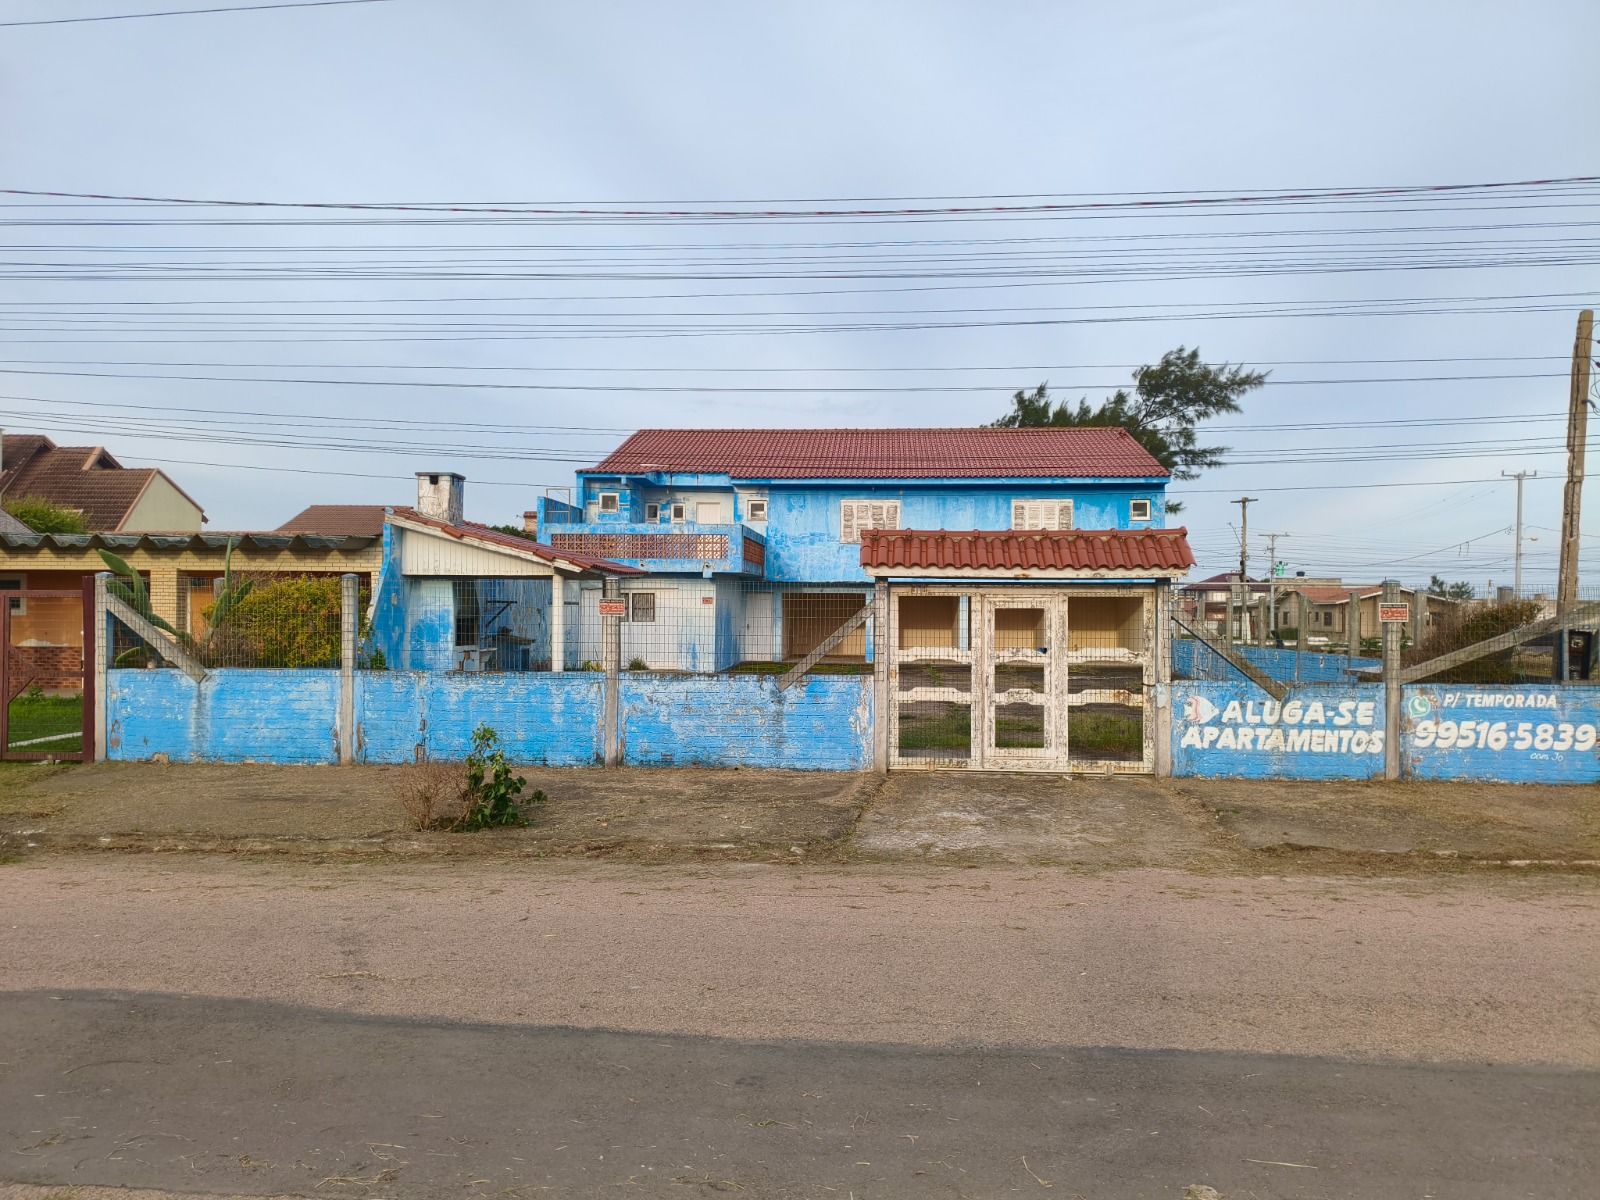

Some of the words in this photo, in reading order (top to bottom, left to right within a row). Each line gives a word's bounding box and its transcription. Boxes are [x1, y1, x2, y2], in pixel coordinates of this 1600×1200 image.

[1221, 700, 1375, 726] ALUGA-SE
[1443, 693, 1461, 708] P/
[1466, 694, 1557, 708] TEMPORADA
[1180, 726, 1385, 754] APARTAMENTOS
